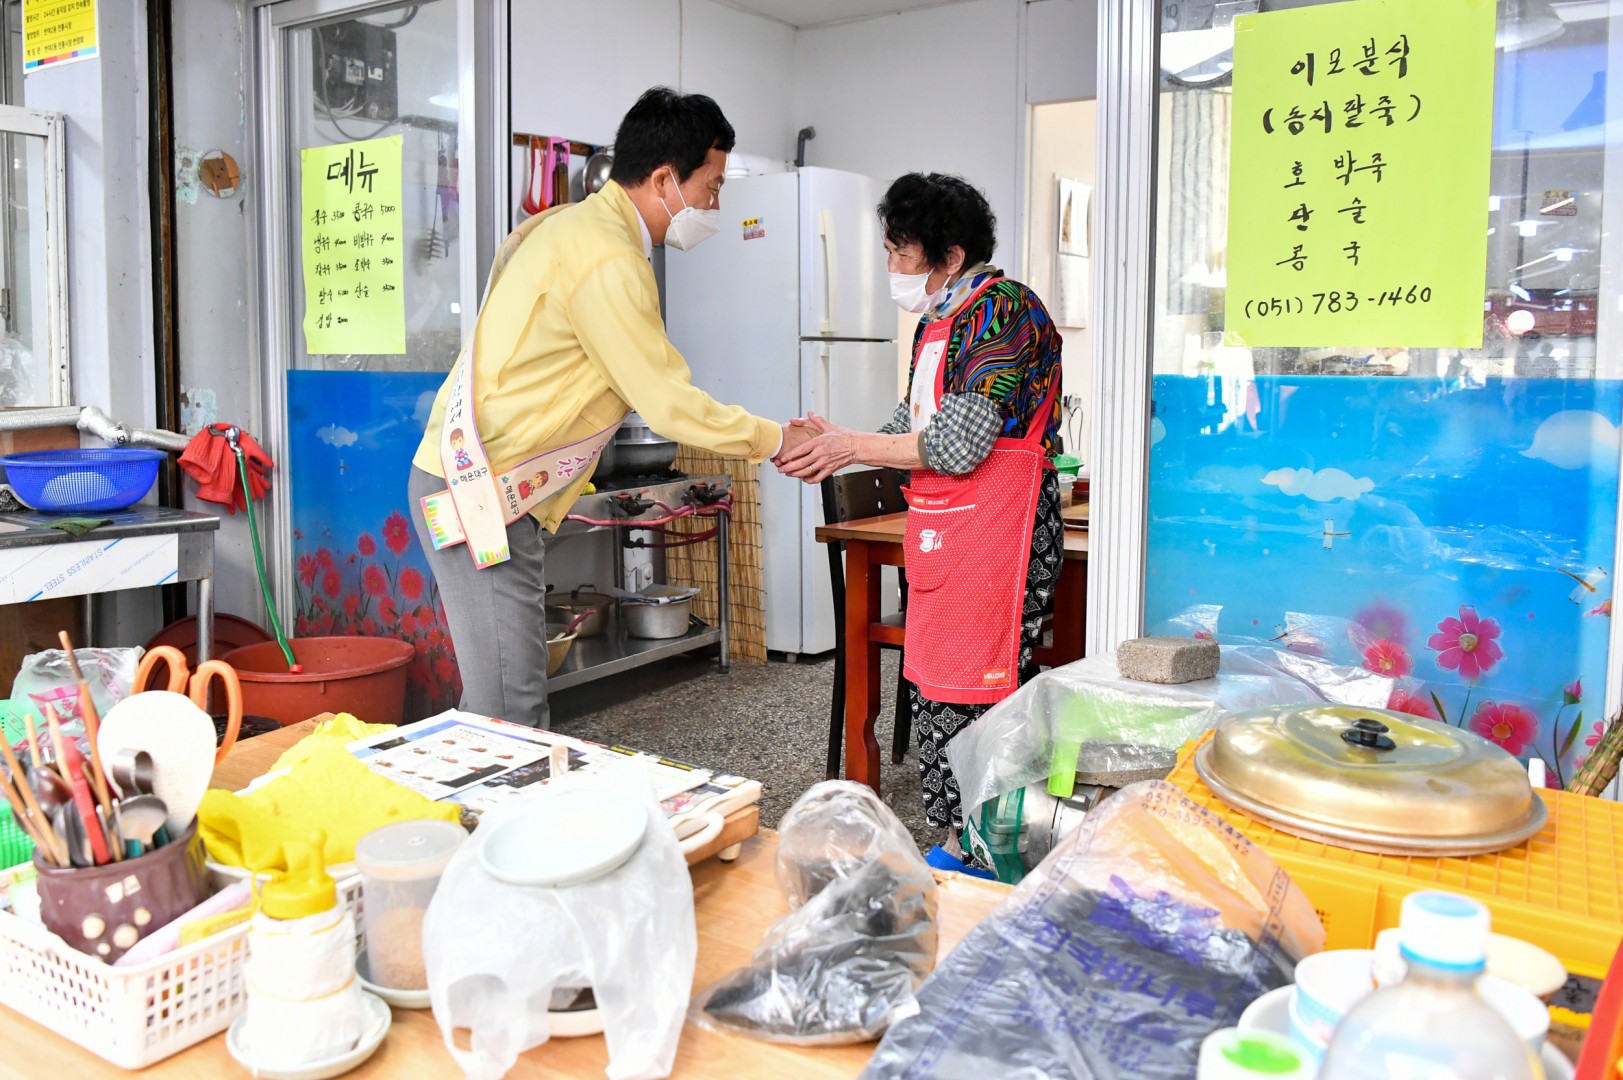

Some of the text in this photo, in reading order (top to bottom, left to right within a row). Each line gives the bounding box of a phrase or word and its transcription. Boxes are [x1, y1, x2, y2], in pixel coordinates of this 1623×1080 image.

[326, 148, 378, 194] 메뉴
[460, 466, 488, 483] 해운대구
[505, 485, 520, 516] 해운대구
[43, 548, 104, 592] STAINLESS STEEL
